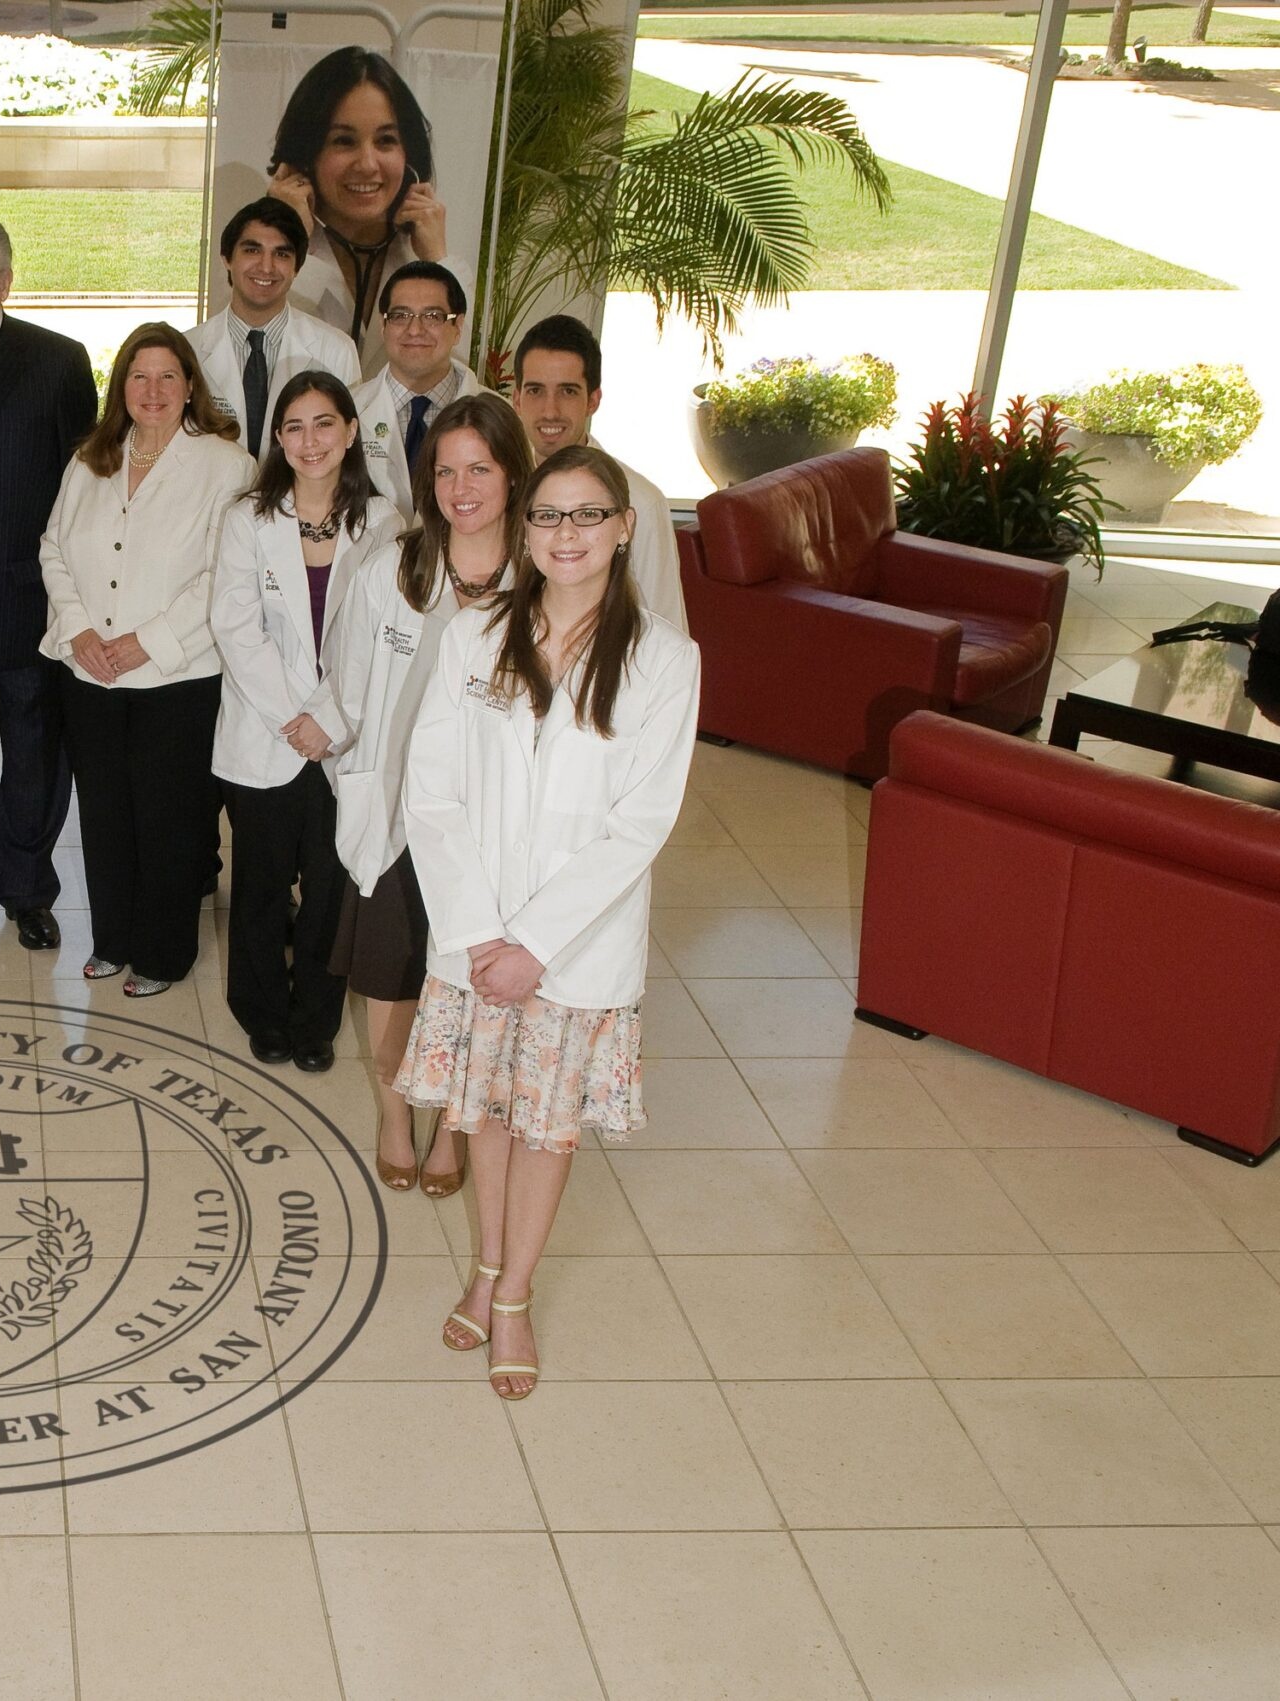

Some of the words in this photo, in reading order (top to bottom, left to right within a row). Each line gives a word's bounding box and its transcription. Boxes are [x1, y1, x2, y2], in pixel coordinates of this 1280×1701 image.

[61, 1042, 143, 1075] OF
[149, 1068, 291, 1166] TEXAS
[94, 1385, 155, 1427] AT
[169, 1331, 263, 1394] SAN
[254, 1190, 320, 1327] ANTONIO
[115, 1189, 228, 1343] CIVITATIS
